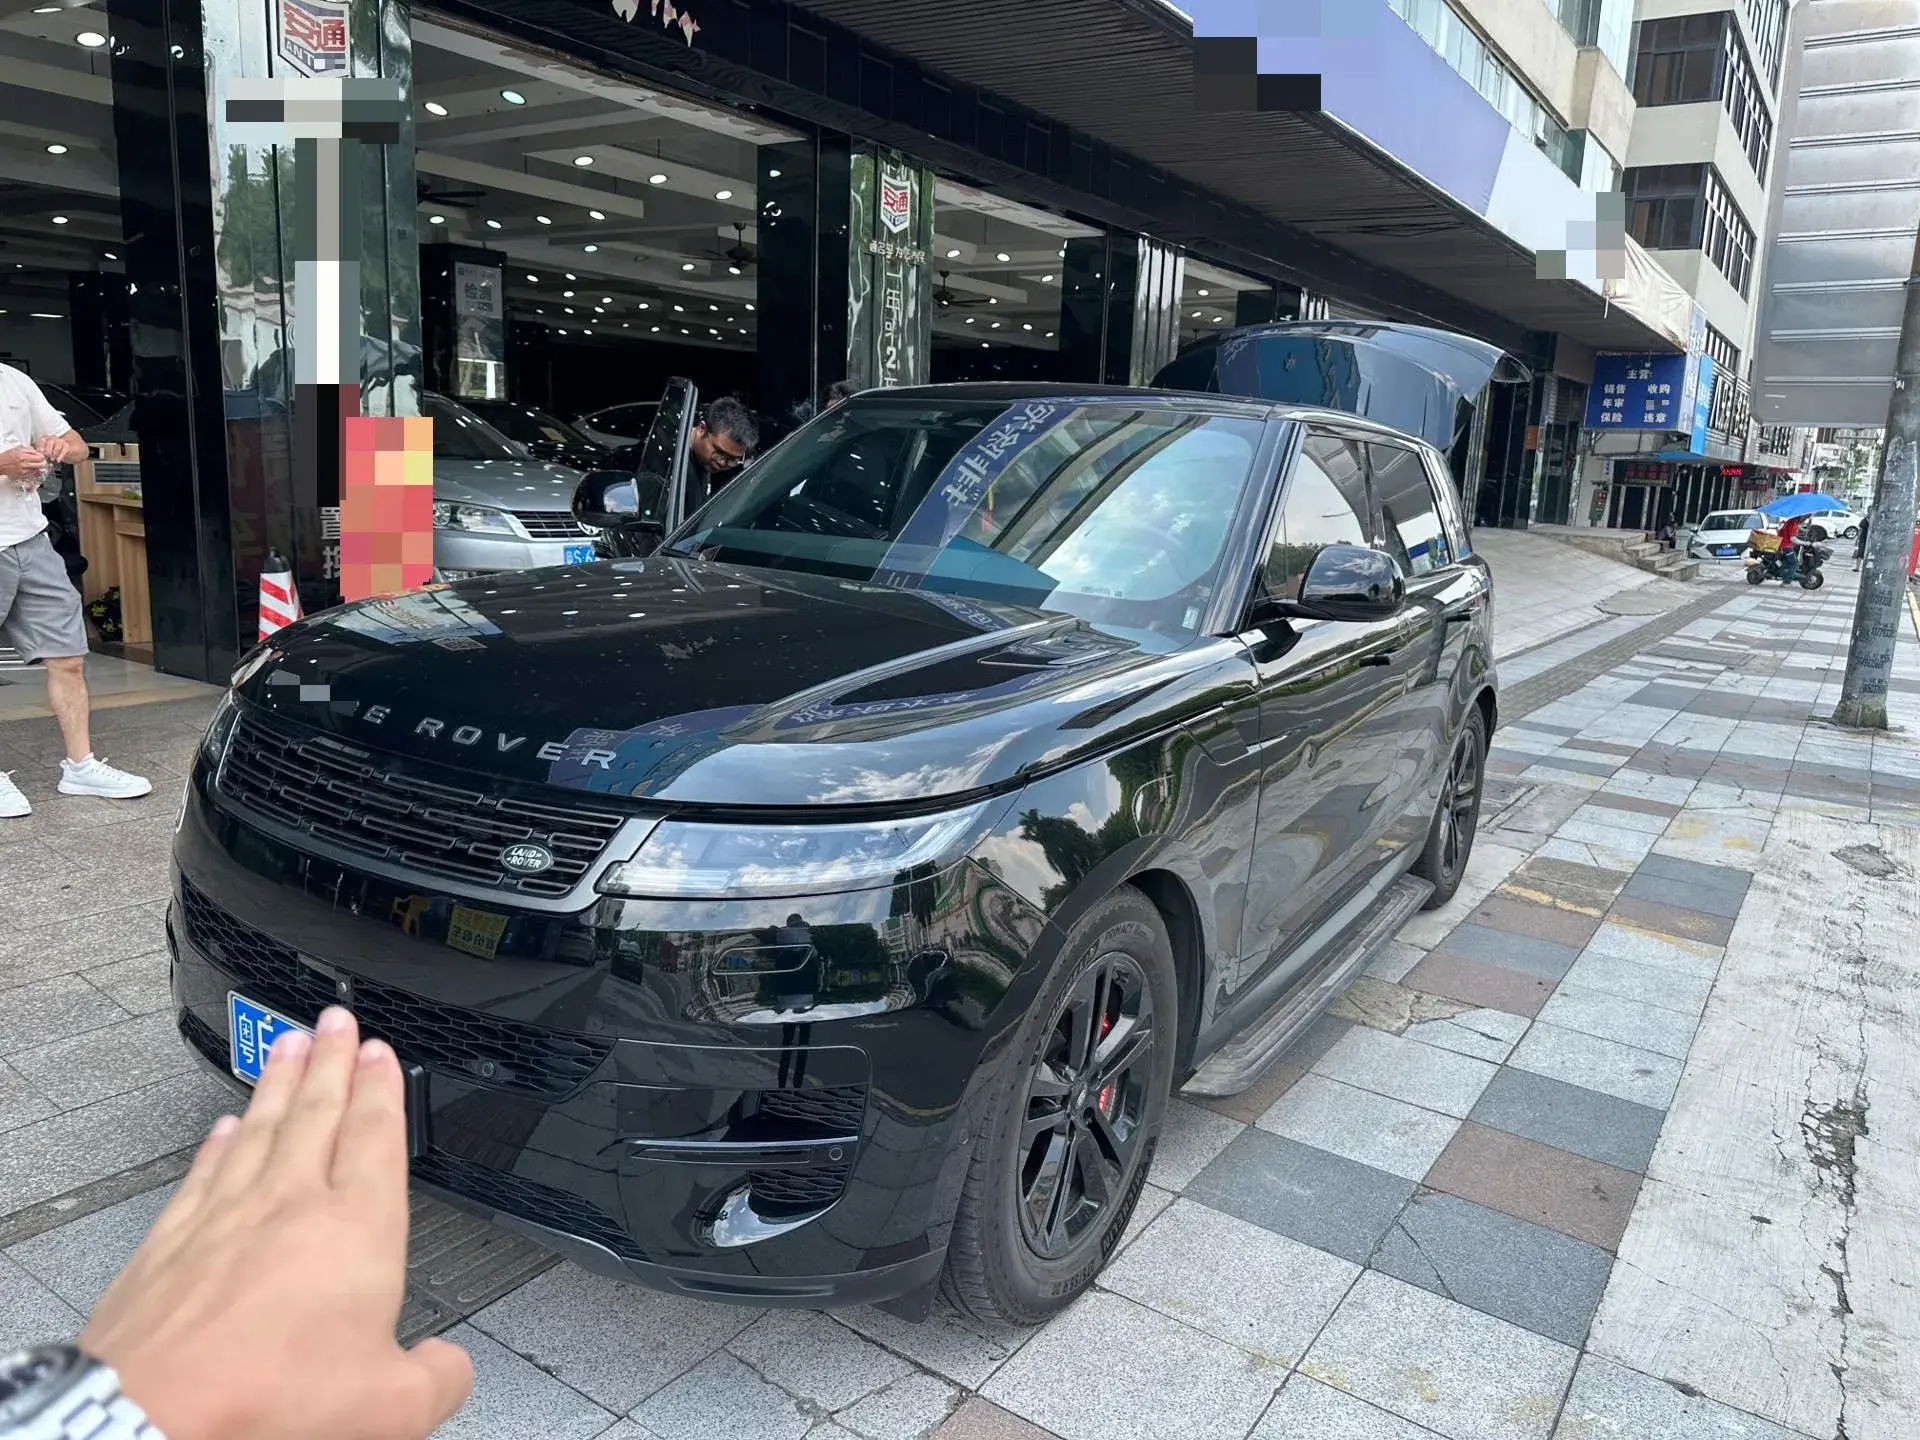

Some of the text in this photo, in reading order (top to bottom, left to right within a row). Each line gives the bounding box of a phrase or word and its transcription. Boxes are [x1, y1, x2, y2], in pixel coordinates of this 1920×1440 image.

[283, 0, 346, 52] 安通
[883, 186, 908, 213] 安通
[1604, 383, 1671, 394] 销售 收购
[1602, 398, 1625, 409] 年审
[1600, 412, 1667, 423] 保险 违章
[510, 847, 537, 858] LAND
[509, 855, 542, 868] ROVER
